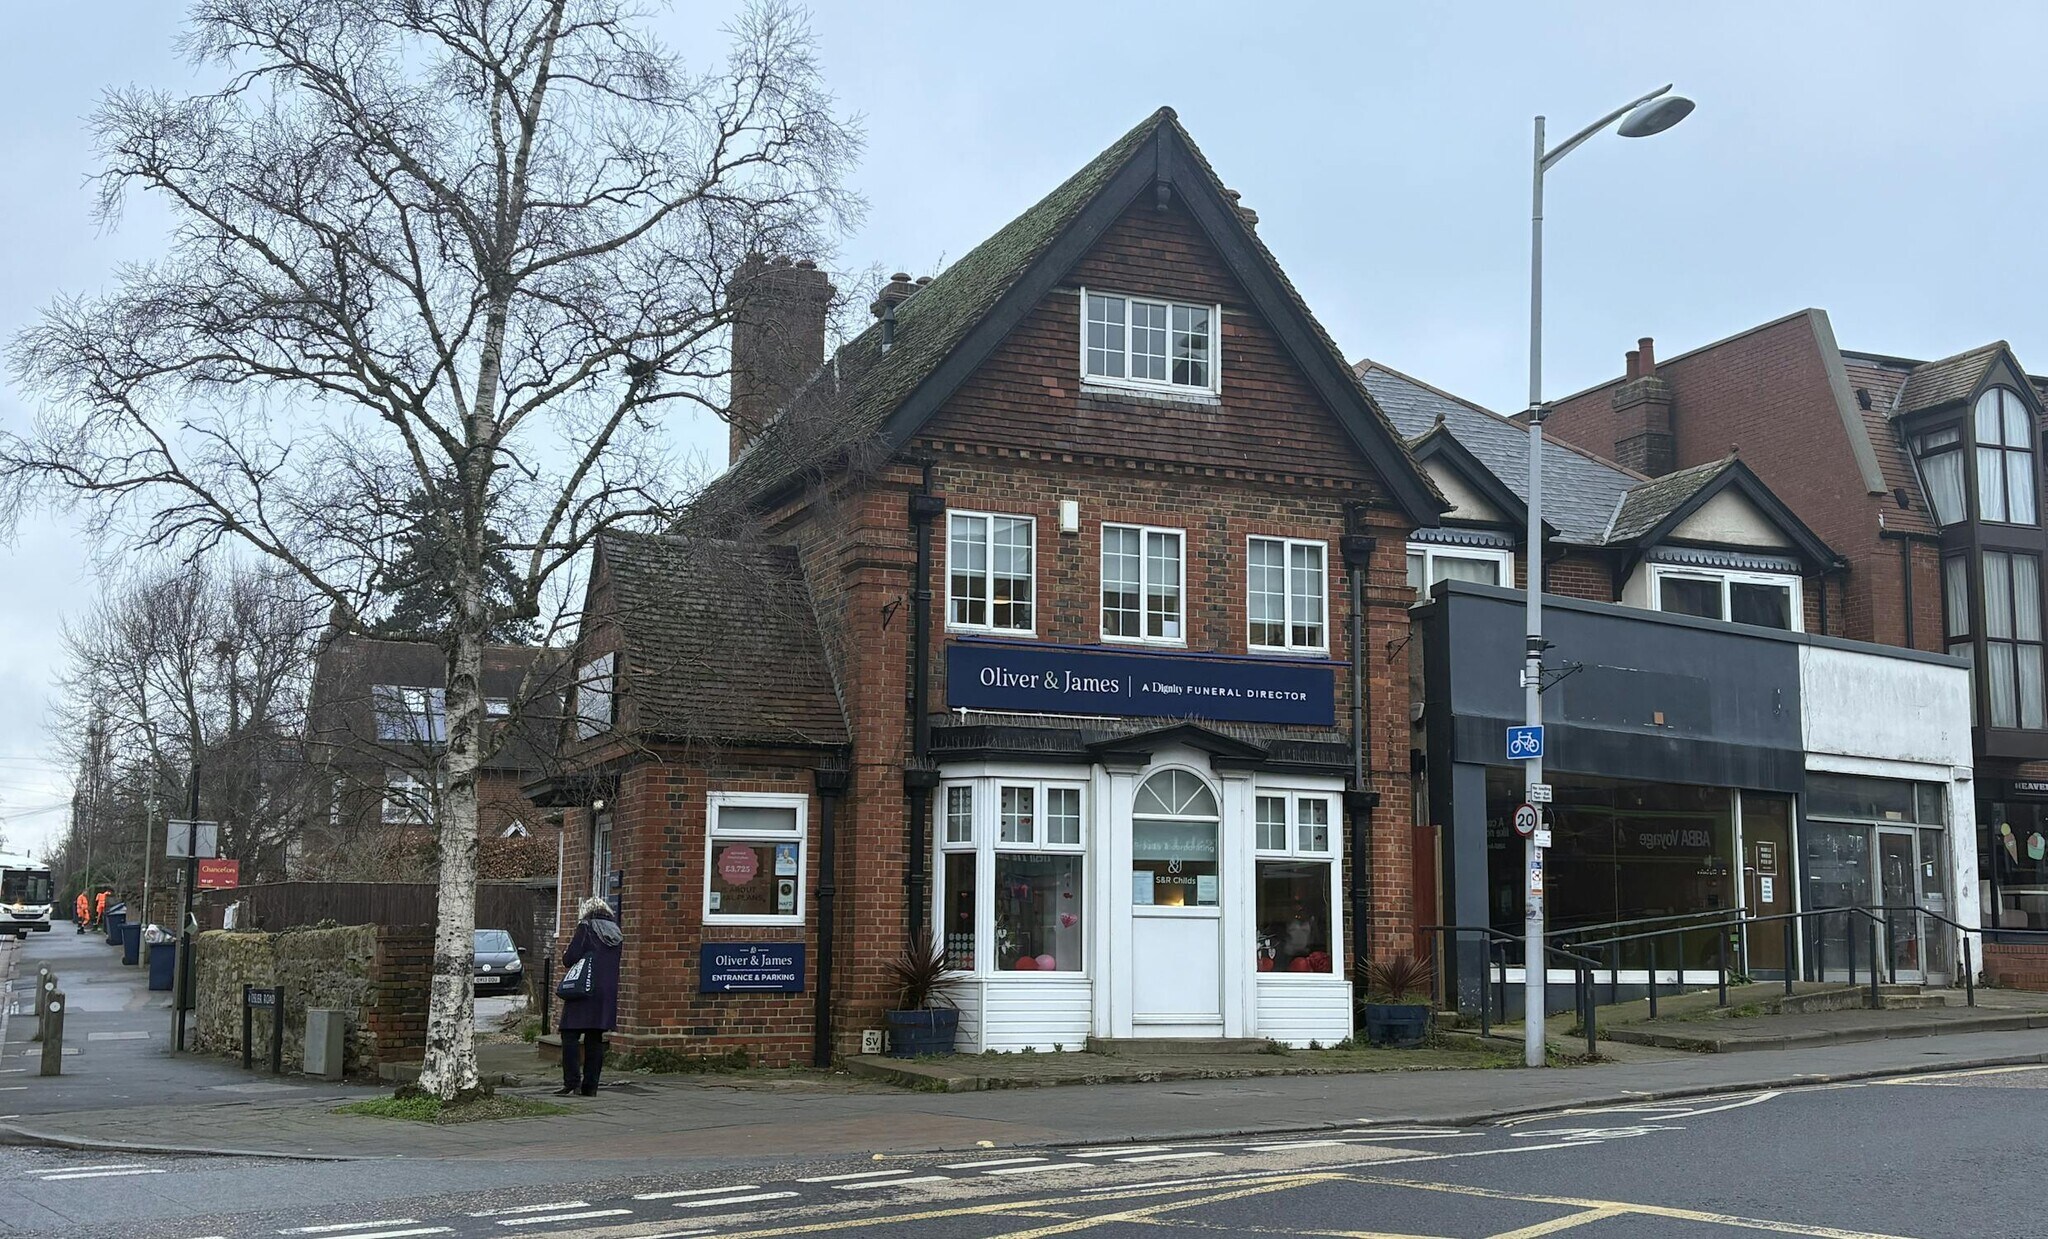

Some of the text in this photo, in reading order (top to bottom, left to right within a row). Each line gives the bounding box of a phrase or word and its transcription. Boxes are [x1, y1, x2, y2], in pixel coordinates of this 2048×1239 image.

[980, 667, 1307, 701] Oliver & James A Dignity FUNERAL DIRECTOR
[2014, 782, 2048, 791] HEAVE
[1517, 813, 1534, 826] 20
[1155, 876, 1196, 885] S&R Childs
[715, 954, 793, 967] Oliver & James
[711, 973, 753, 982] ENTRANCE
[761, 973, 795, 981] PARKING
[865, 1037, 879, 1046] SV
